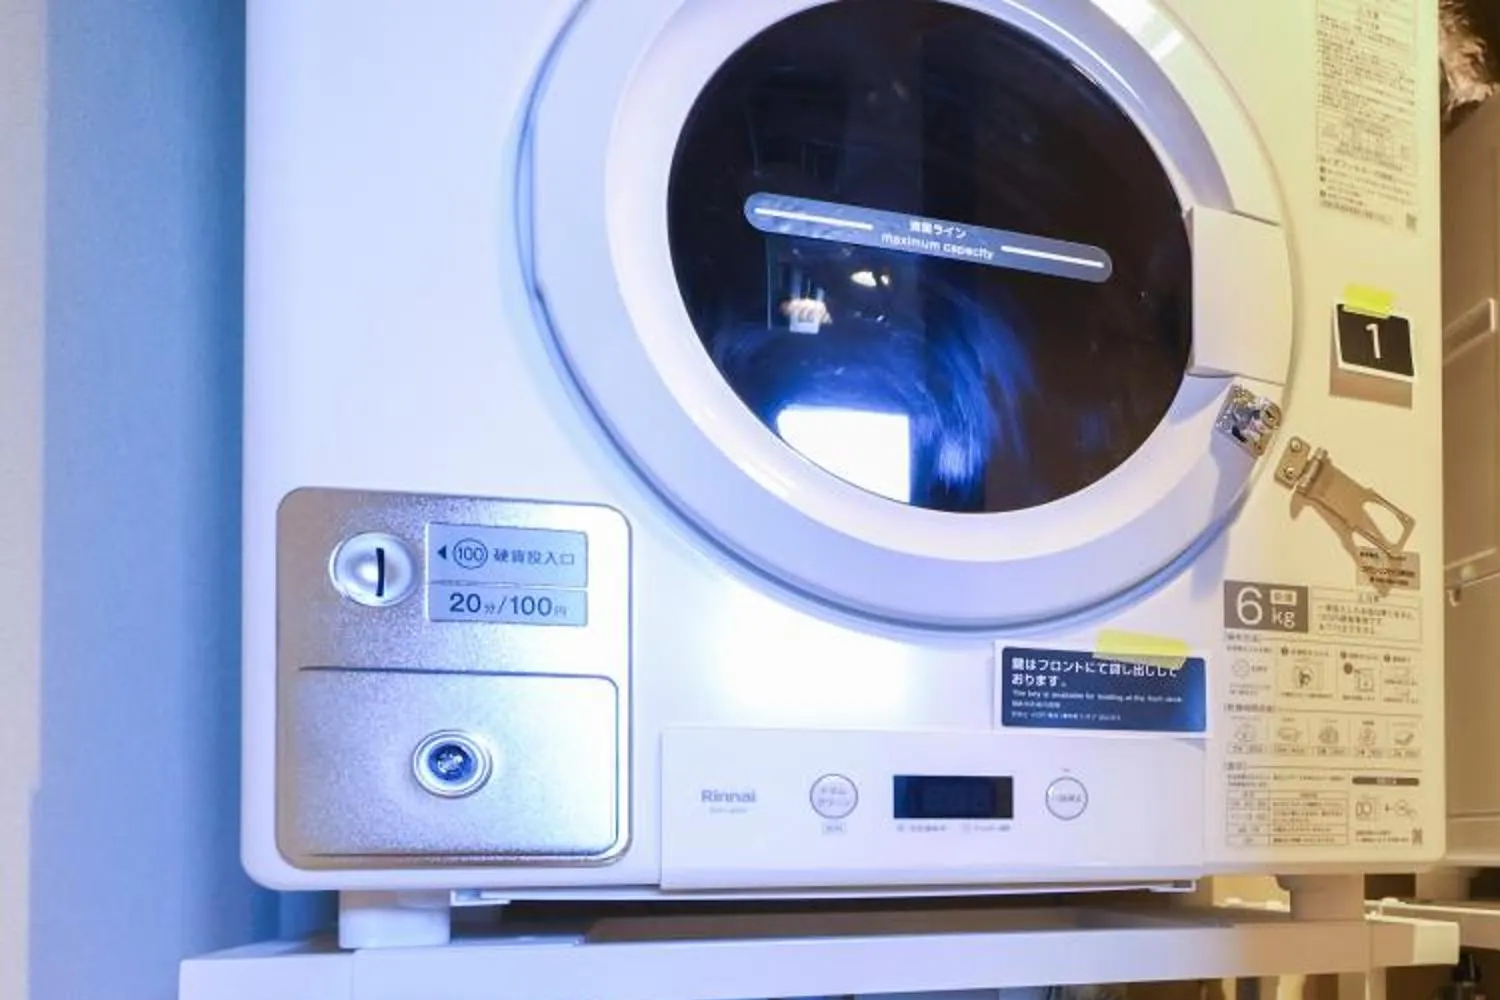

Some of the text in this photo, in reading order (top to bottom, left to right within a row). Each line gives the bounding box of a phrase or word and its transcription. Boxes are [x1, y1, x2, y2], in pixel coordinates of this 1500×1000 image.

[881, 231, 994, 260] maximum capacity
[1365, 323, 1381, 359] 1
[458, 546, 575, 565] 100 硬貨投入口
[1236, 587, 1295, 629] 6 kg
[1011, 674, 1066, 687] おります。
[701, 789, 757, 803] Rinnai
